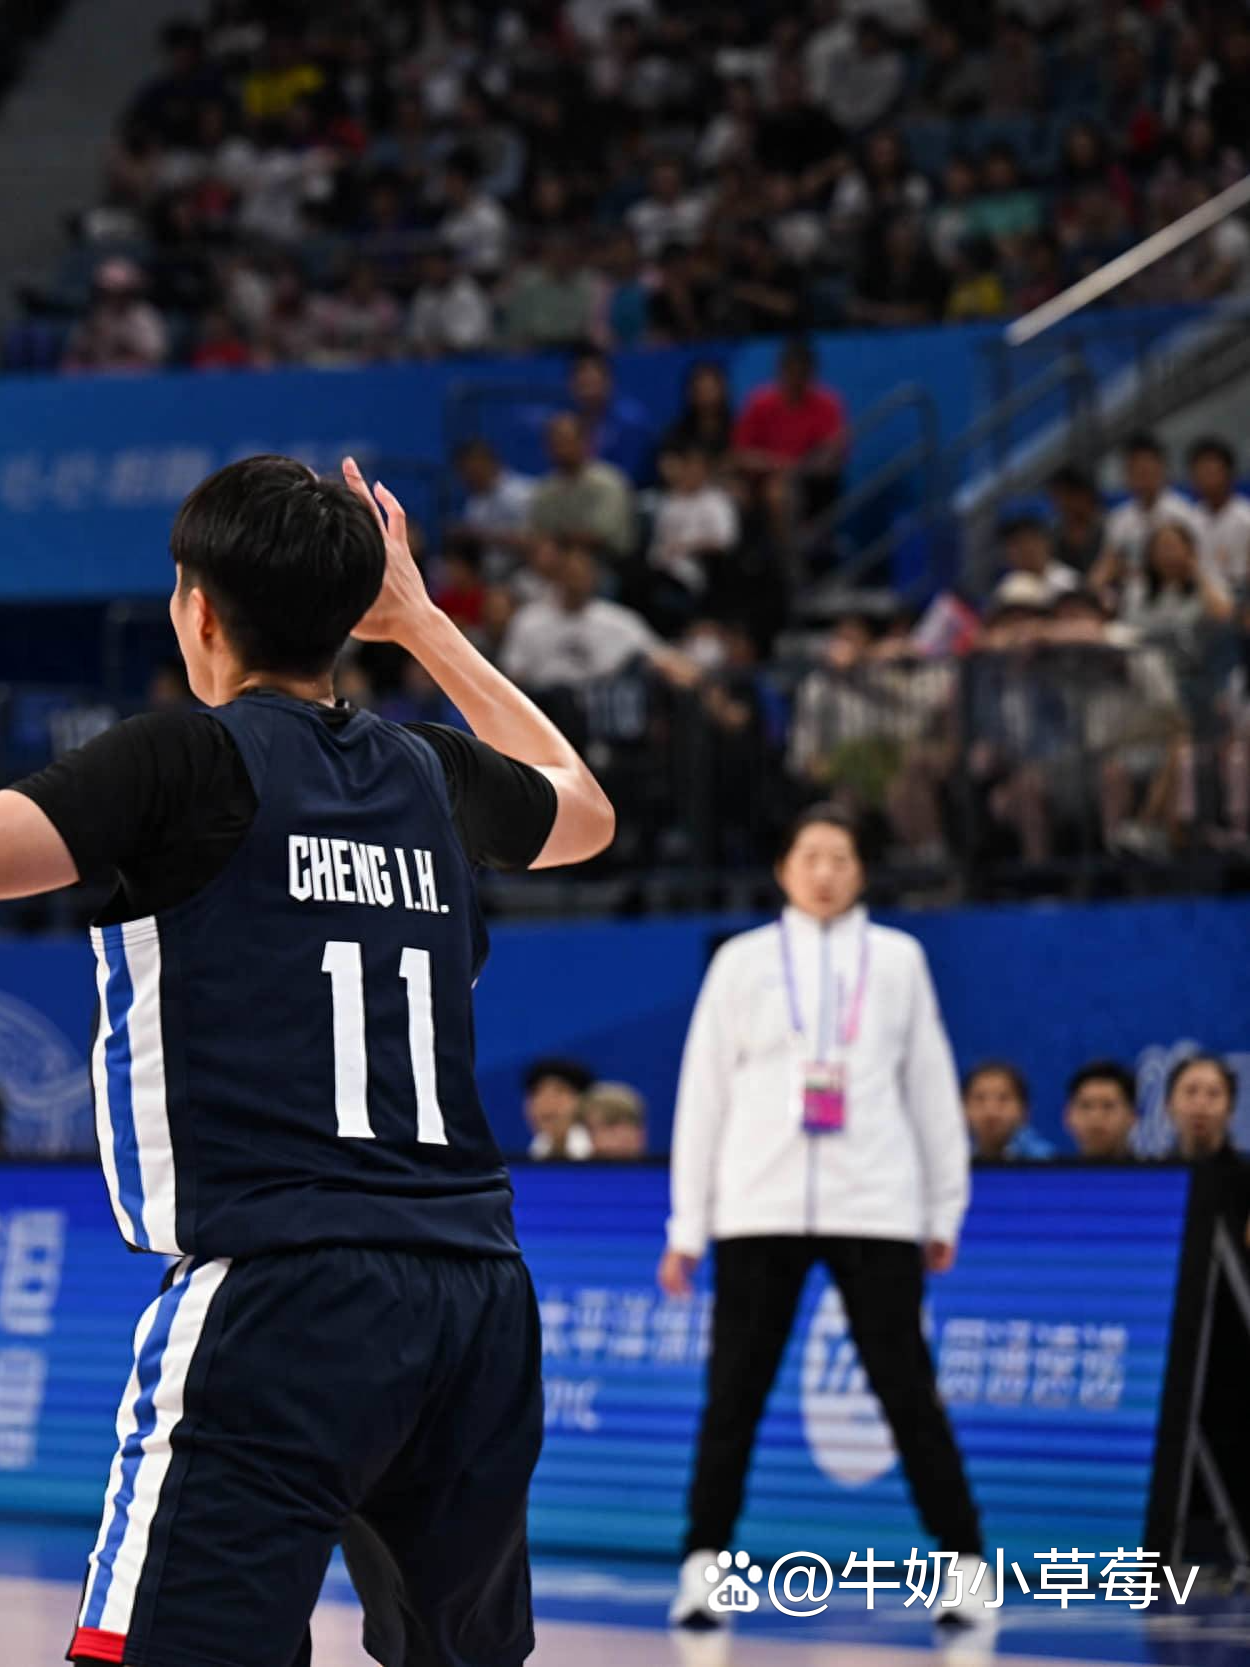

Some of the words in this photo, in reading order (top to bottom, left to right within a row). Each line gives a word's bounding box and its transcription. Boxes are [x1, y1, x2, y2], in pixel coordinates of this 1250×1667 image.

[288, 835, 393, 908] CHENG
[395, 848, 450, 914] I.H.
[320, 941, 450, 1146] 11
